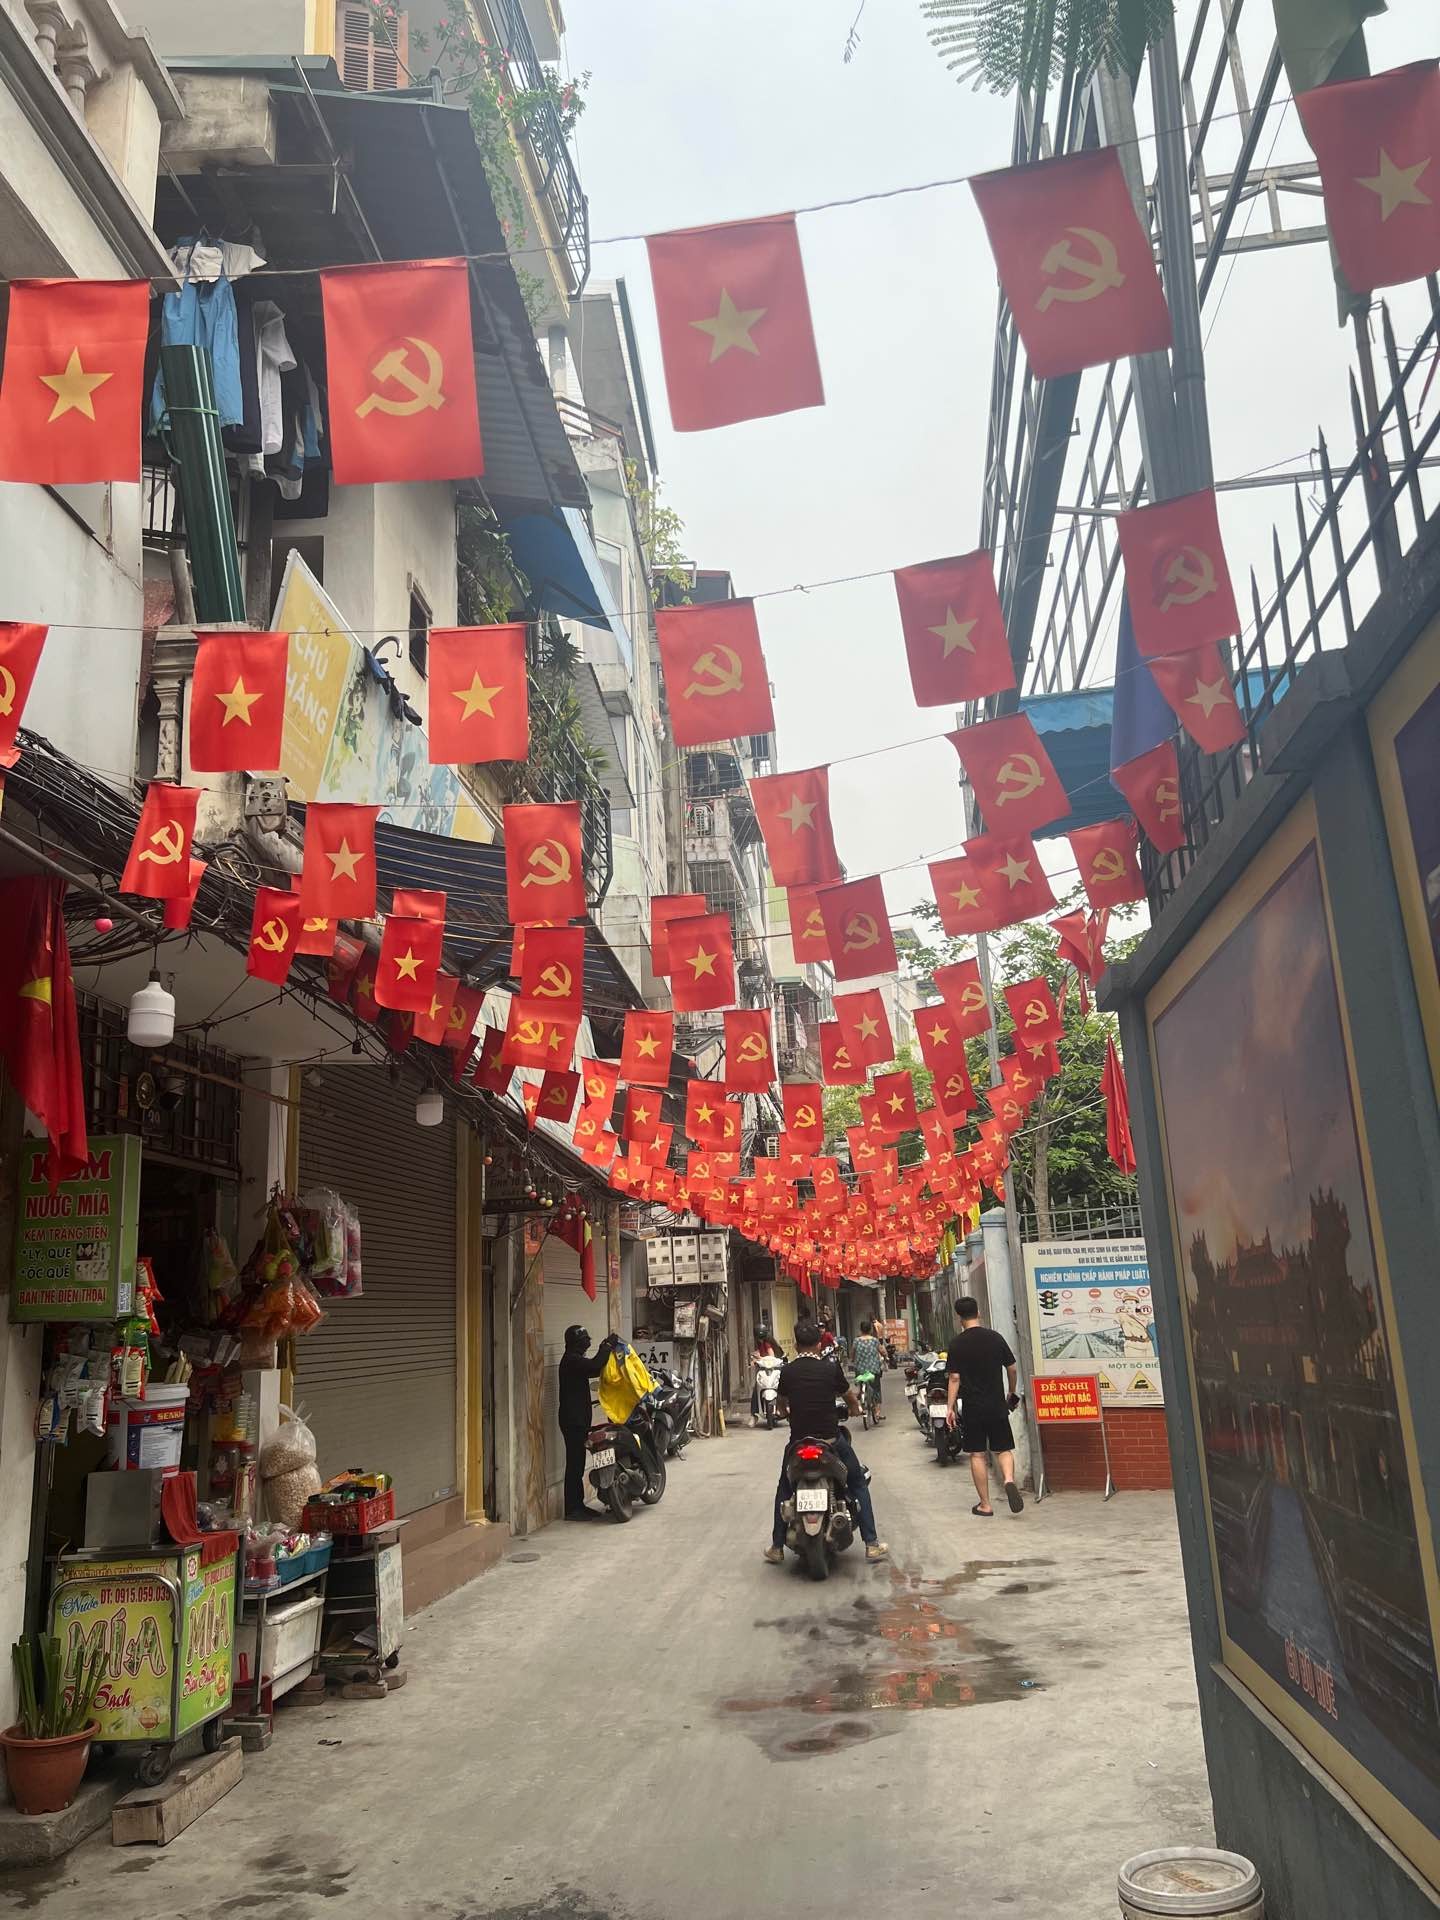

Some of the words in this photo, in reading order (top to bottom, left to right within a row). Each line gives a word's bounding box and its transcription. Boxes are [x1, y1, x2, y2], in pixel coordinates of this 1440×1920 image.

[30, 1150, 113, 1184] KM
[76, 1187, 110, 1217] MÍA
[24, 1228, 46, 1241] KEM
[48, 1247, 71, 1260] QUE
[638, 1346, 669, 1364] CẮT
[1060, 1381, 1089, 1392] NGHỊ
[1041, 1392, 1063, 1404] KHÔNG
[1064, 1391, 1077, 1403] VỨT
[1078, 1391, 1092, 1403] RÁC
[186, 1586, 231, 1666] MÍA
[64, 1607, 168, 1680] MÍA
